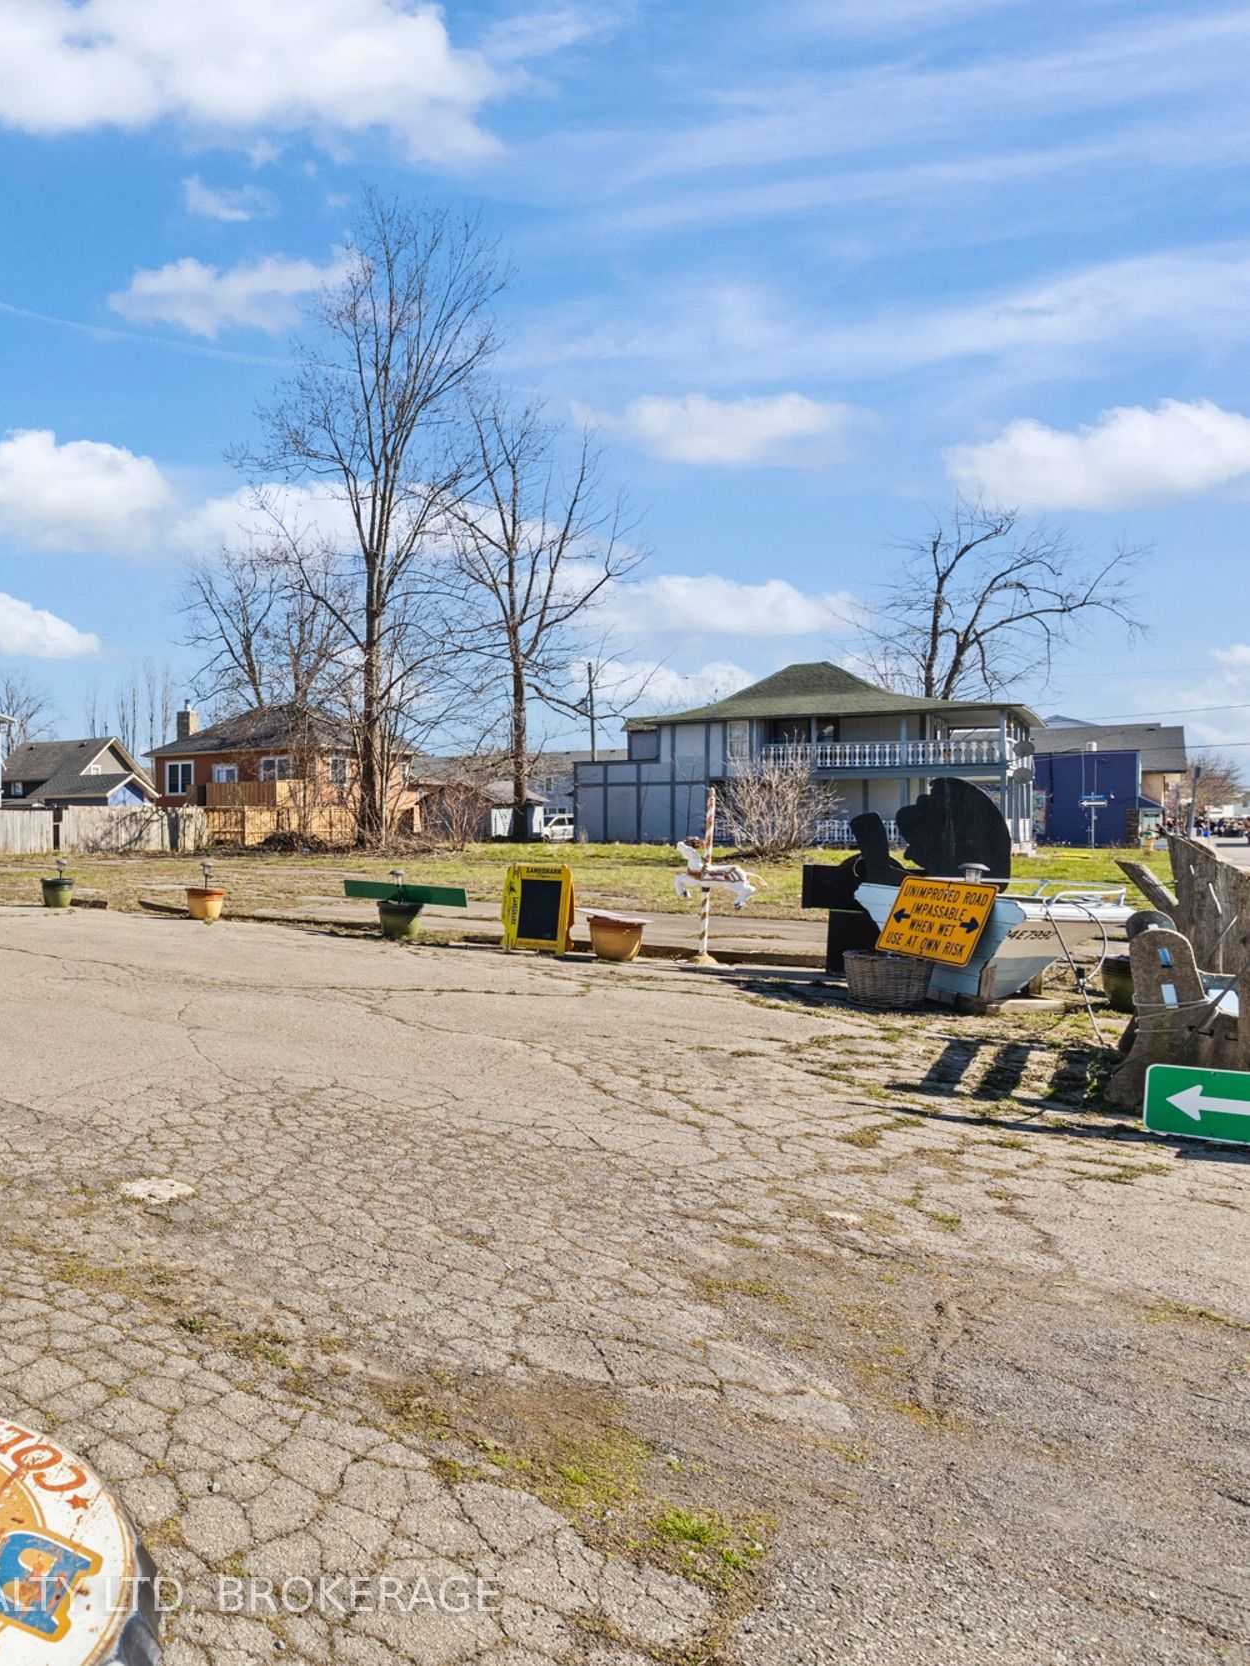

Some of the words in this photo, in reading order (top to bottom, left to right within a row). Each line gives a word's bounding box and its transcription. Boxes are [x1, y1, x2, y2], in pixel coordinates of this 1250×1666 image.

[903, 884, 961, 903] UNIMPROVED
[962, 891, 989, 907] ROAD
[911, 902, 967, 922] IMPASSABLE
[908, 918, 935, 934] WHEN
[938, 923, 956, 937] WET
[886, 931, 902, 945] USE
[905, 935, 917, 948] AT
[920, 939, 940, 953] OWN
[942, 942, 966, 957] RISK
